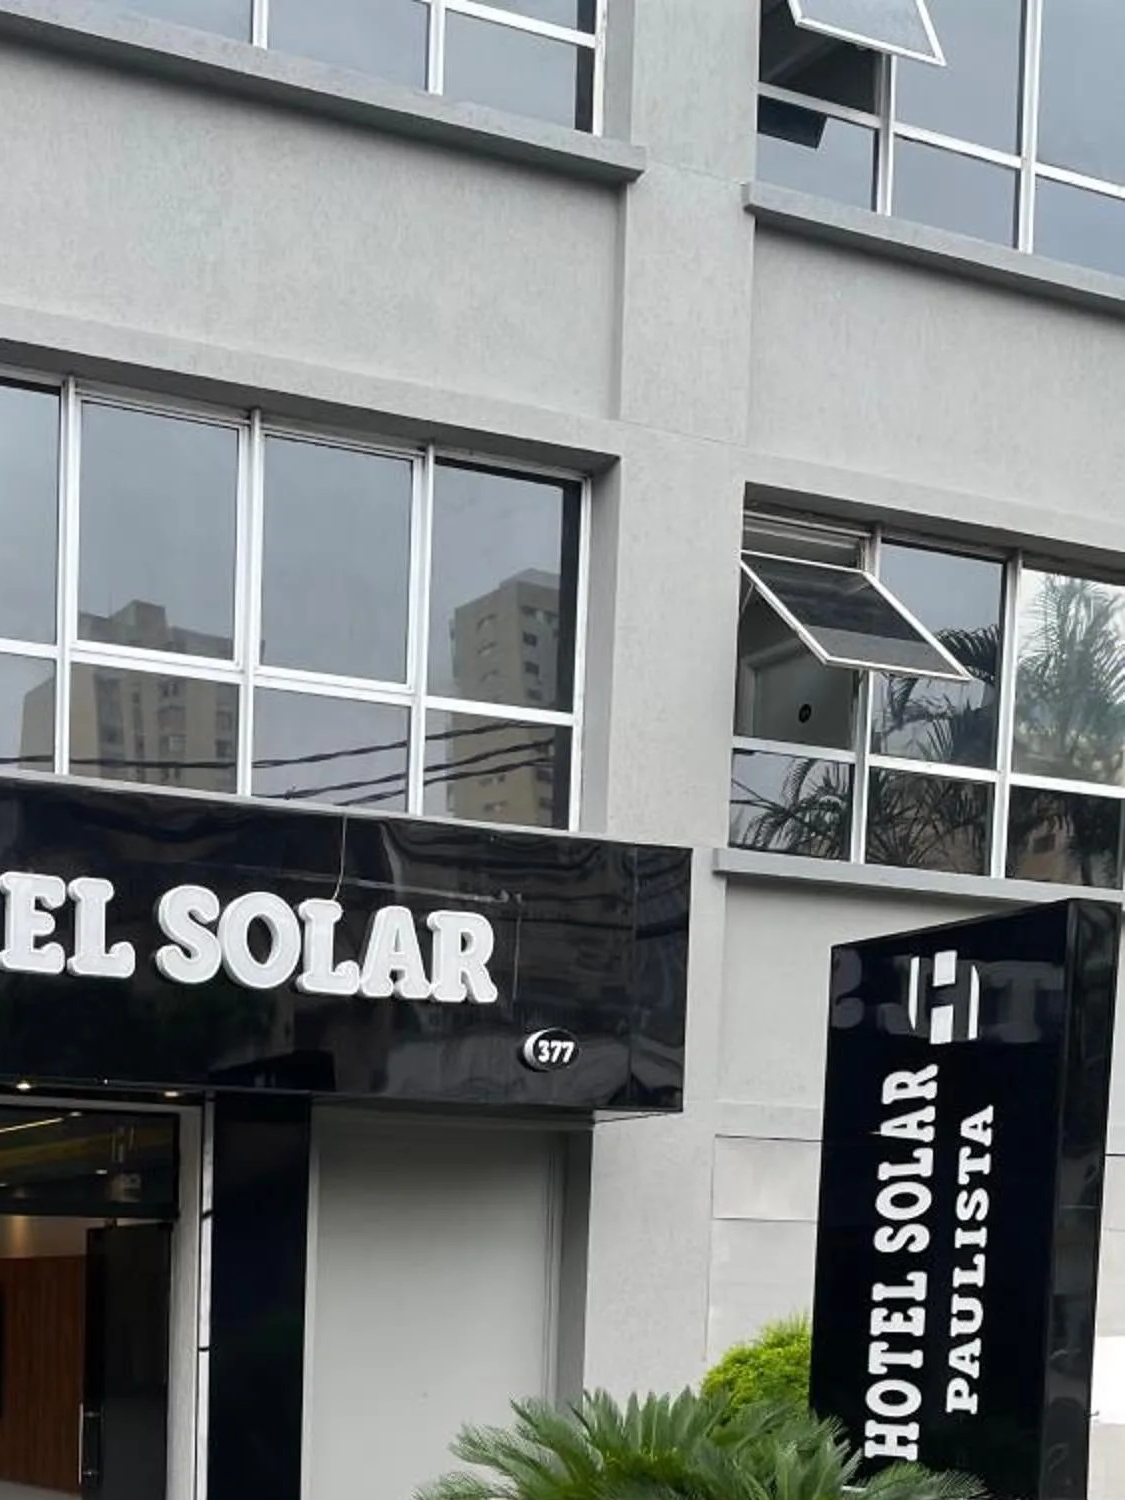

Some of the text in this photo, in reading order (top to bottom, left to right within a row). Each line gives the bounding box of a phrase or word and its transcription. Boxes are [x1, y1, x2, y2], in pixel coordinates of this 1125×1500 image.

[155, 884, 498, 1003] SOLAR
[537, 1039, 576, 1063] 377
[864, 1063, 939, 1462] HOTEL SOLAR
[946, 1104, 995, 1416] PAULISTA
